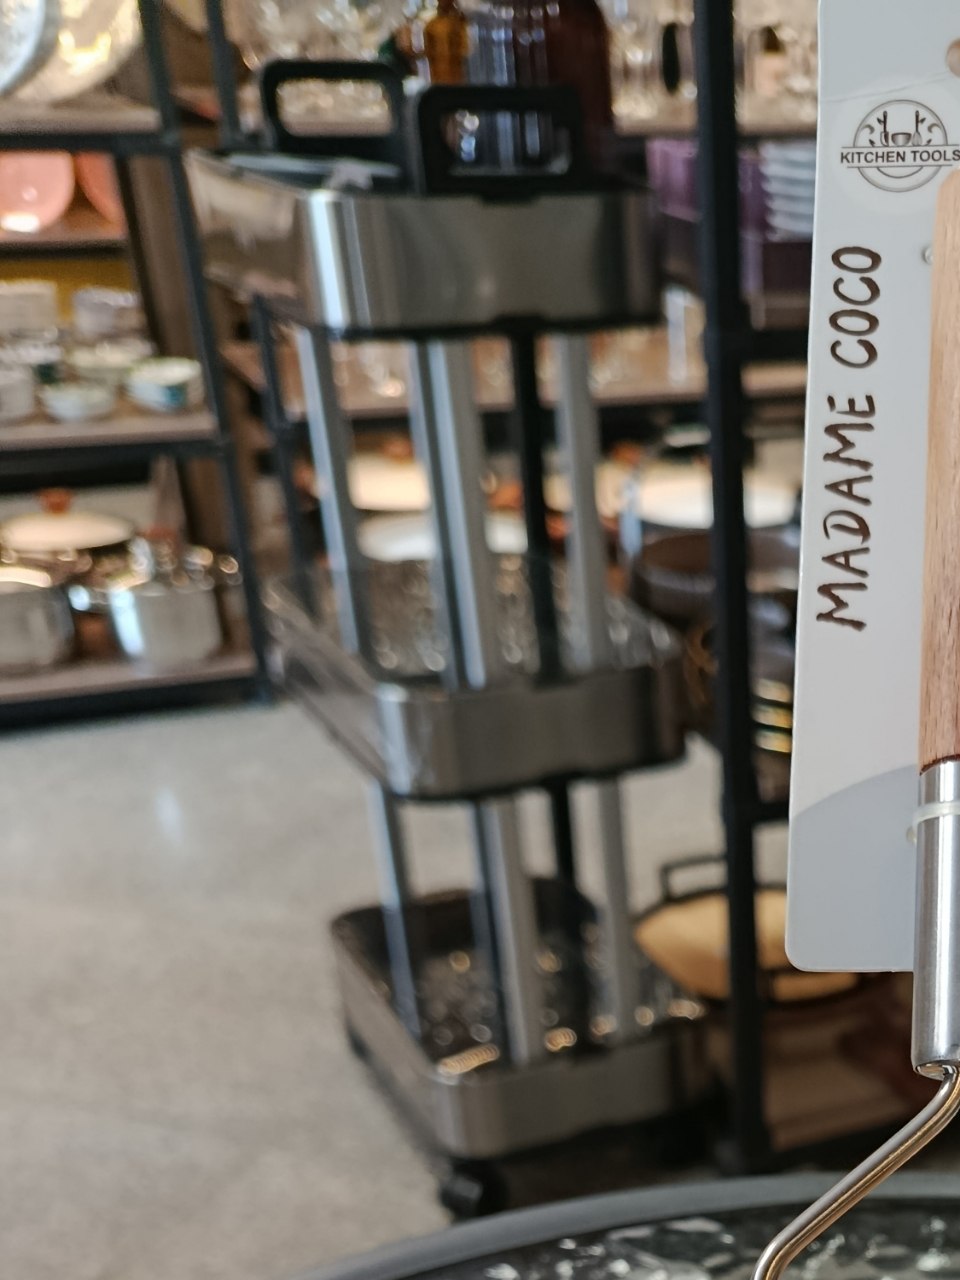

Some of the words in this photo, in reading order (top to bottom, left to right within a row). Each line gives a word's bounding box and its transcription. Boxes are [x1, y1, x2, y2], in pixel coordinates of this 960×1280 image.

[840, 150, 906, 164] KITCHEN
[829, 245, 882, 369] COCO
[816, 395, 877, 632] MADAME
